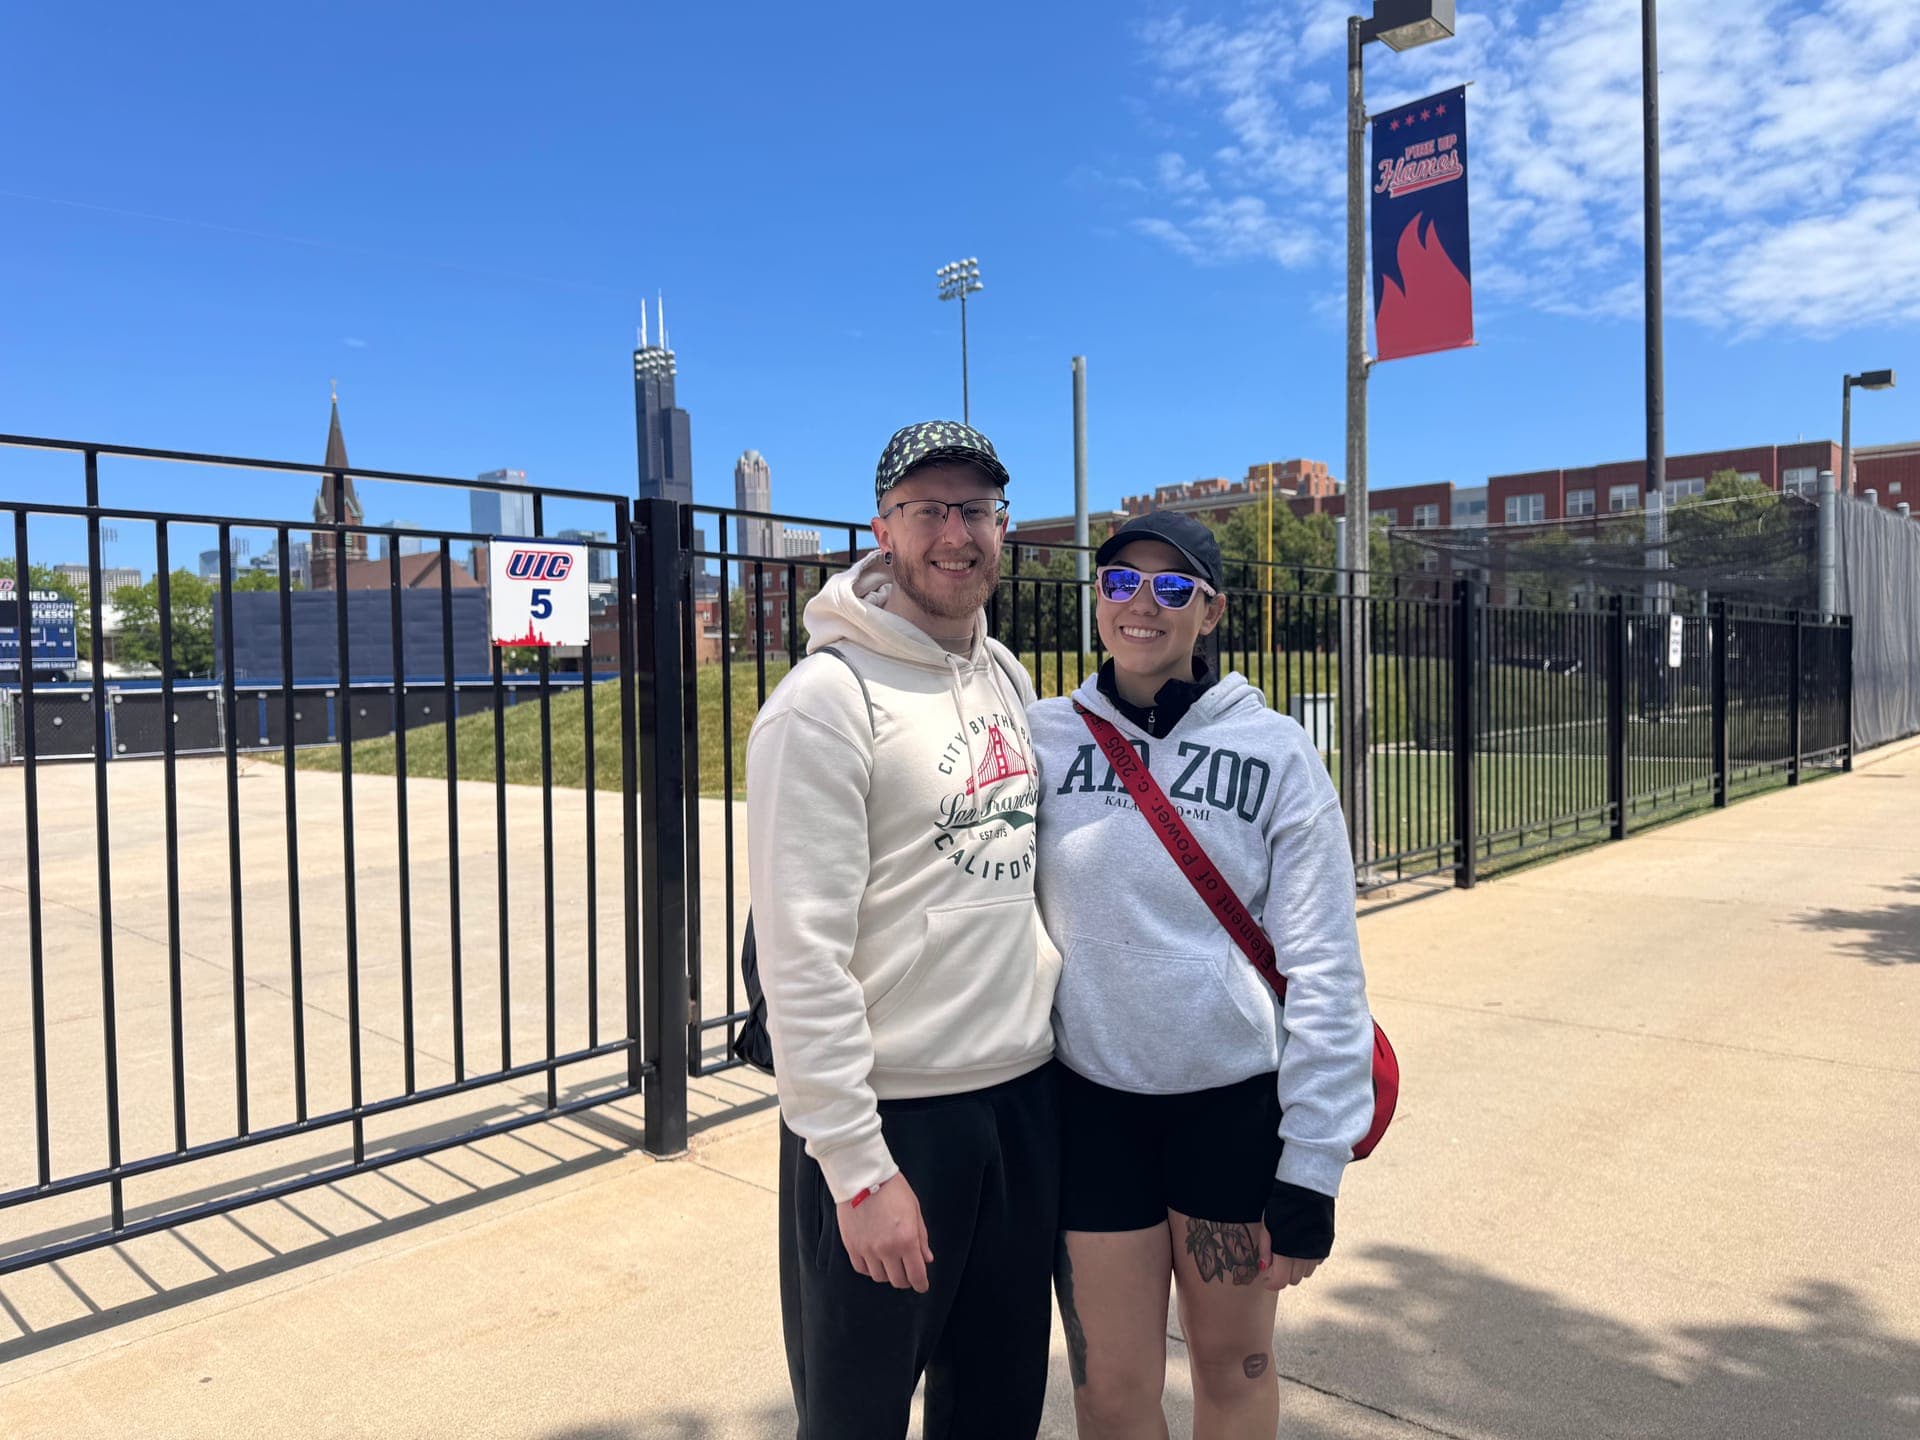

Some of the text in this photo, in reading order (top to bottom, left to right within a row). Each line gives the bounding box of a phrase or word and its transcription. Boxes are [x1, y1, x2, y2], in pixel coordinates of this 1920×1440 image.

[1405, 133, 1457, 160] FIRE UP
[1374, 149, 1462, 194] Flames
[506, 550, 573, 581] UIC
[28, 591, 58, 601] IELD
[32, 602, 73, 610] GORDON
[531, 588, 553, 620] 5
[32, 610, 73, 619] FLESCH
[938, 732, 968, 775] CITY
[969, 715, 985, 735] BY
[1104, 737, 1138, 777] 2005
[1170, 740, 1271, 824] ZOO
[935, 792, 977, 829] San
[1195, 871, 1218, 890] of
[1216, 894, 1275, 970] Element
